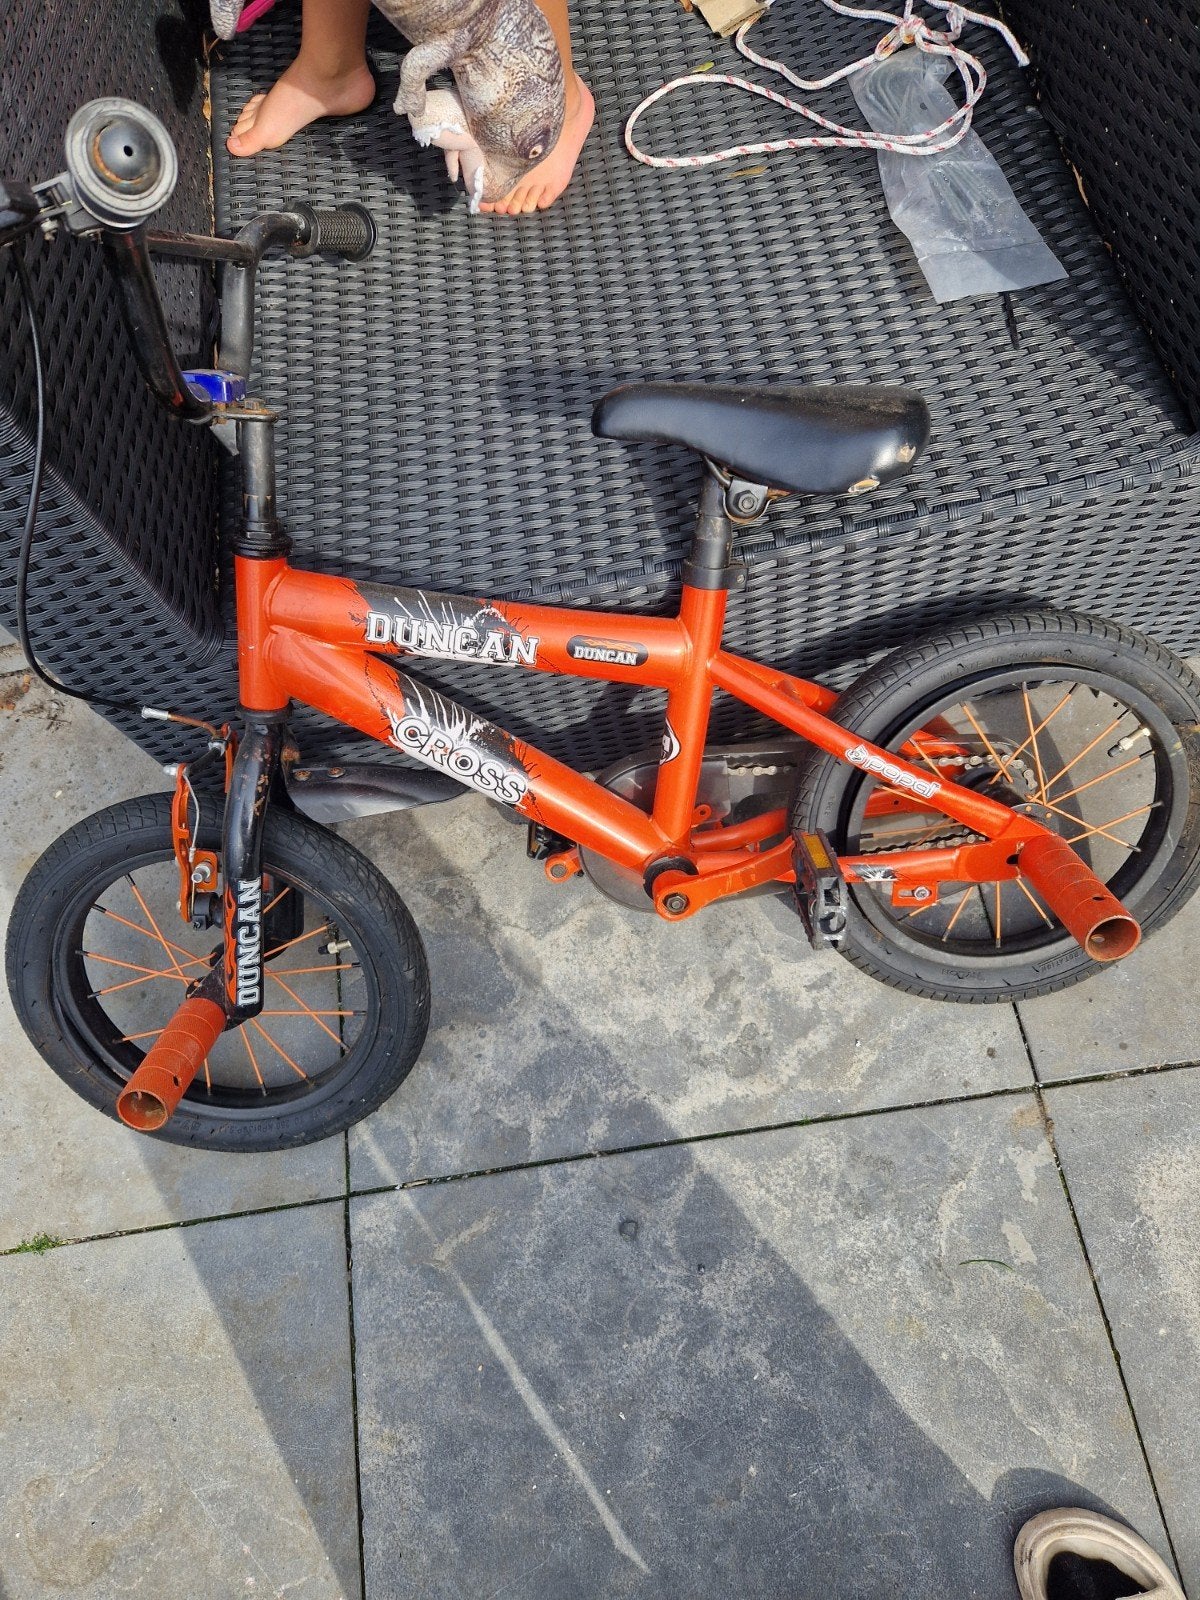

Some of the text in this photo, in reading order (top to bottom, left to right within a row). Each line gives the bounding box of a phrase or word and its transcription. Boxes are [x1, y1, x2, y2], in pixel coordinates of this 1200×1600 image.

[366, 611, 539, 665] DUNCAN
[573, 645, 638, 666] DUNCAN
[395, 715, 529, 805] CROSS
[237, 877, 262, 1007] DUNCAN
